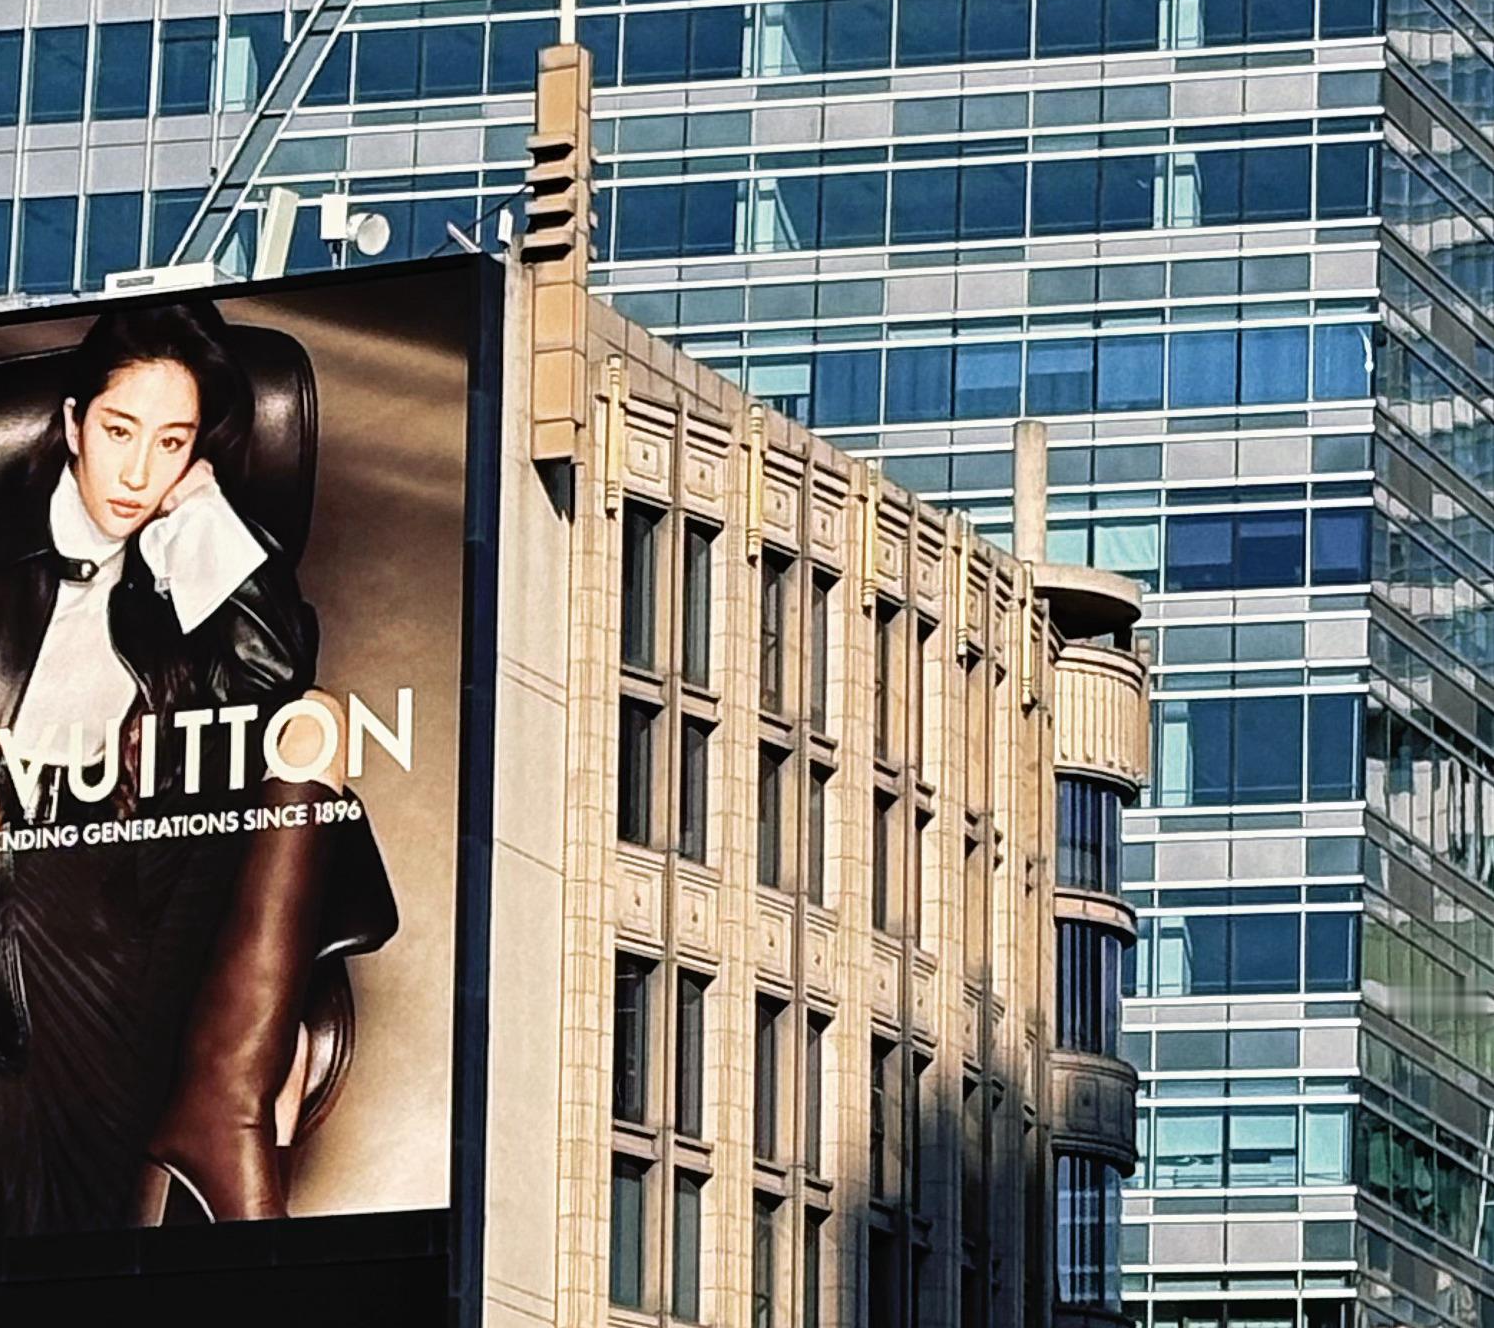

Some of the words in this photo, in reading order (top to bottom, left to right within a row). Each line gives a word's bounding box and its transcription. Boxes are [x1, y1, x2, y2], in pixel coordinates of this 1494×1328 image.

[82, 810, 239, 846] GENERATIONS
[243, 802, 308, 831] SINCE
[313, 799, 362, 825] 1896
